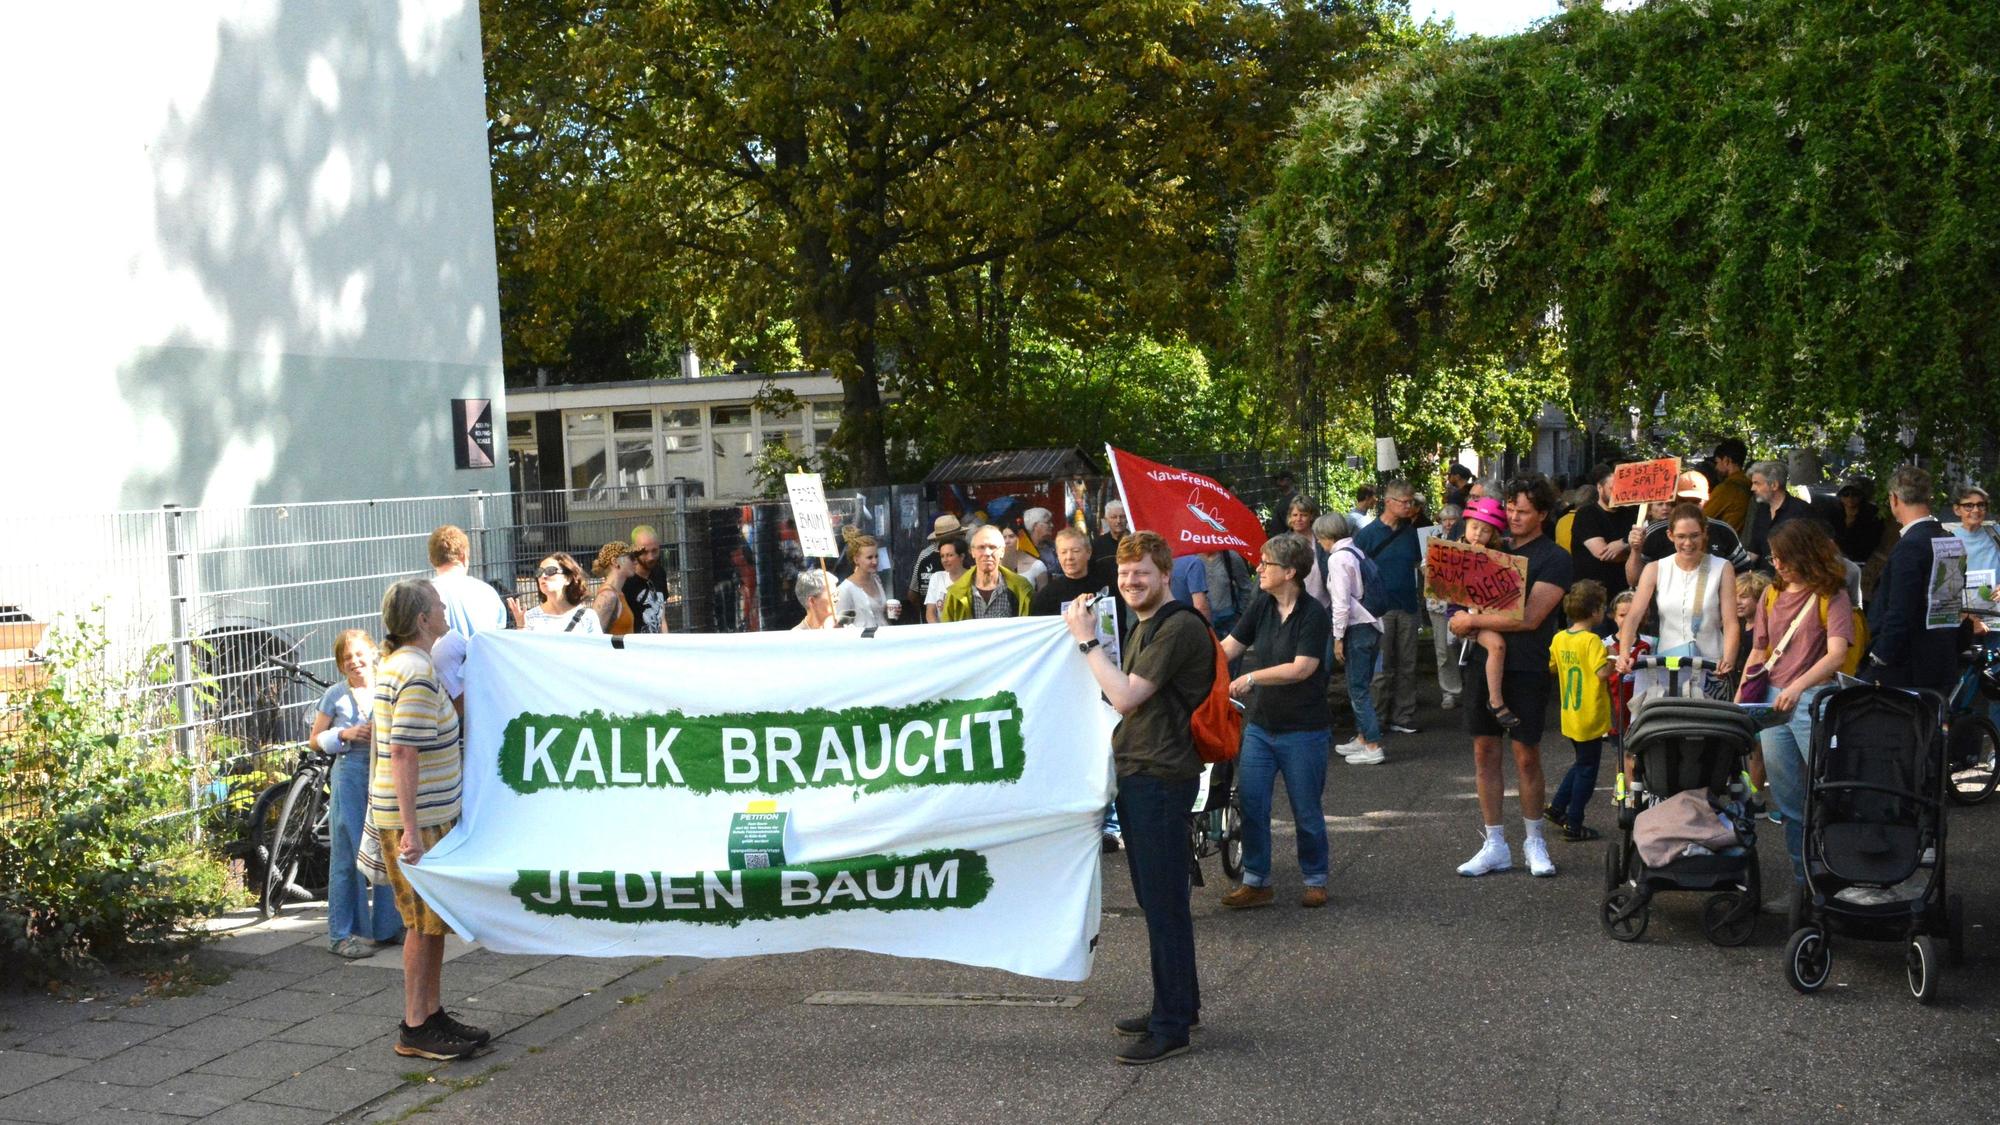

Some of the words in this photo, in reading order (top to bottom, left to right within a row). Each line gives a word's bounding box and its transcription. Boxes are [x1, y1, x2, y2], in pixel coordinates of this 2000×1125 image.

[1619, 467, 1632, 479] ES
[1431, 544, 1489, 571] JEDER
[1427, 564, 1465, 584] BAUM
[522, 726, 685, 784] KALK
[721, 710, 1012, 784] BRAUCHT
[740, 813, 779, 821] PETITION
[531, 870, 744, 909] JEDEN
[781, 859, 959, 907] BAUM
